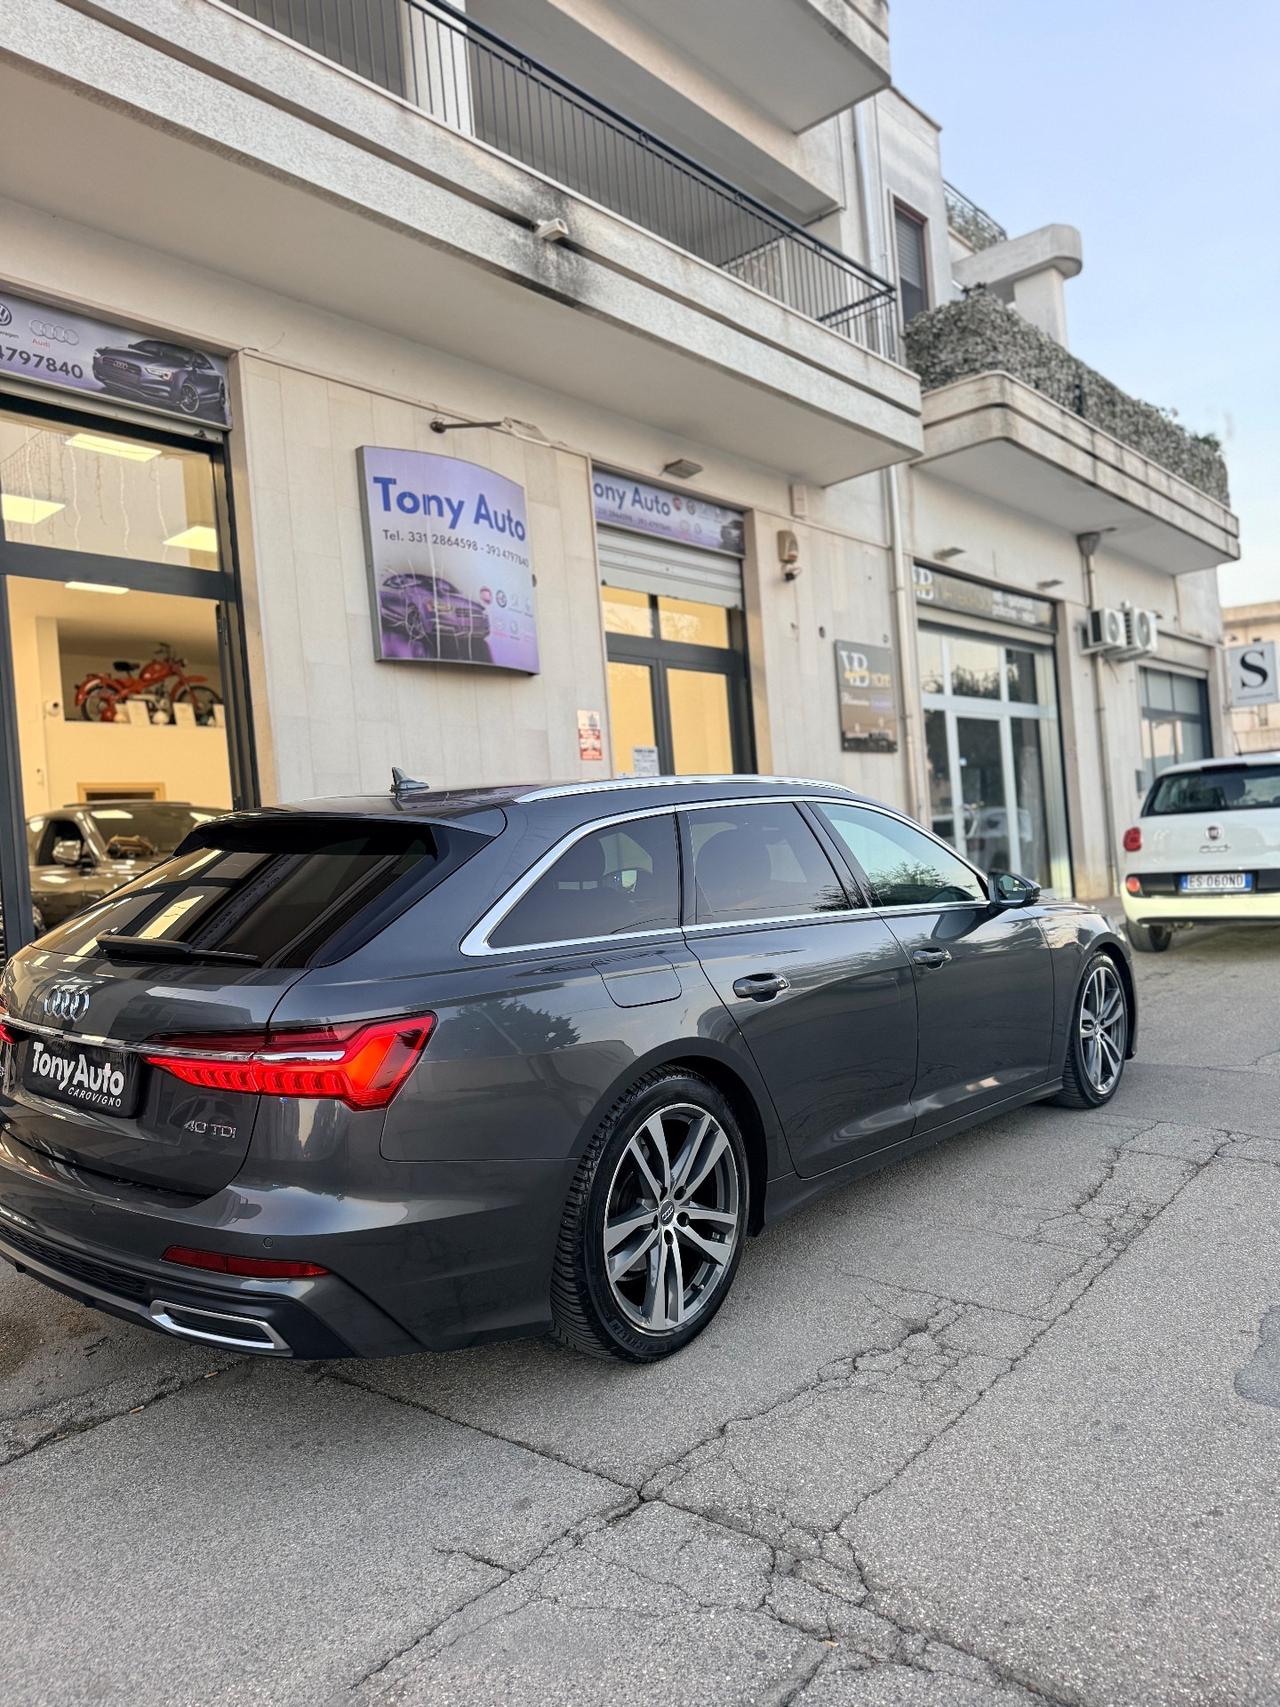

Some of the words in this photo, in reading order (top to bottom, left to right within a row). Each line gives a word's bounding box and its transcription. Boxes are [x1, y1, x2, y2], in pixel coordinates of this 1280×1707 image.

[373, 476, 465, 530] Tony
[473, 493, 526, 542] Auto
[593, 482, 626, 510] ony
[631, 486, 671, 517] Auto
[382, 529, 405, 541] Tel.
[408, 531, 428, 543] 331
[432, 534, 478, 552] 2864598
[1240, 650, 1268, 689] S
[67, 1087, 123, 1108] CAROVIGNO
[183, 1119, 208, 1134] 40
[210, 1123, 237, 1139] TDI
